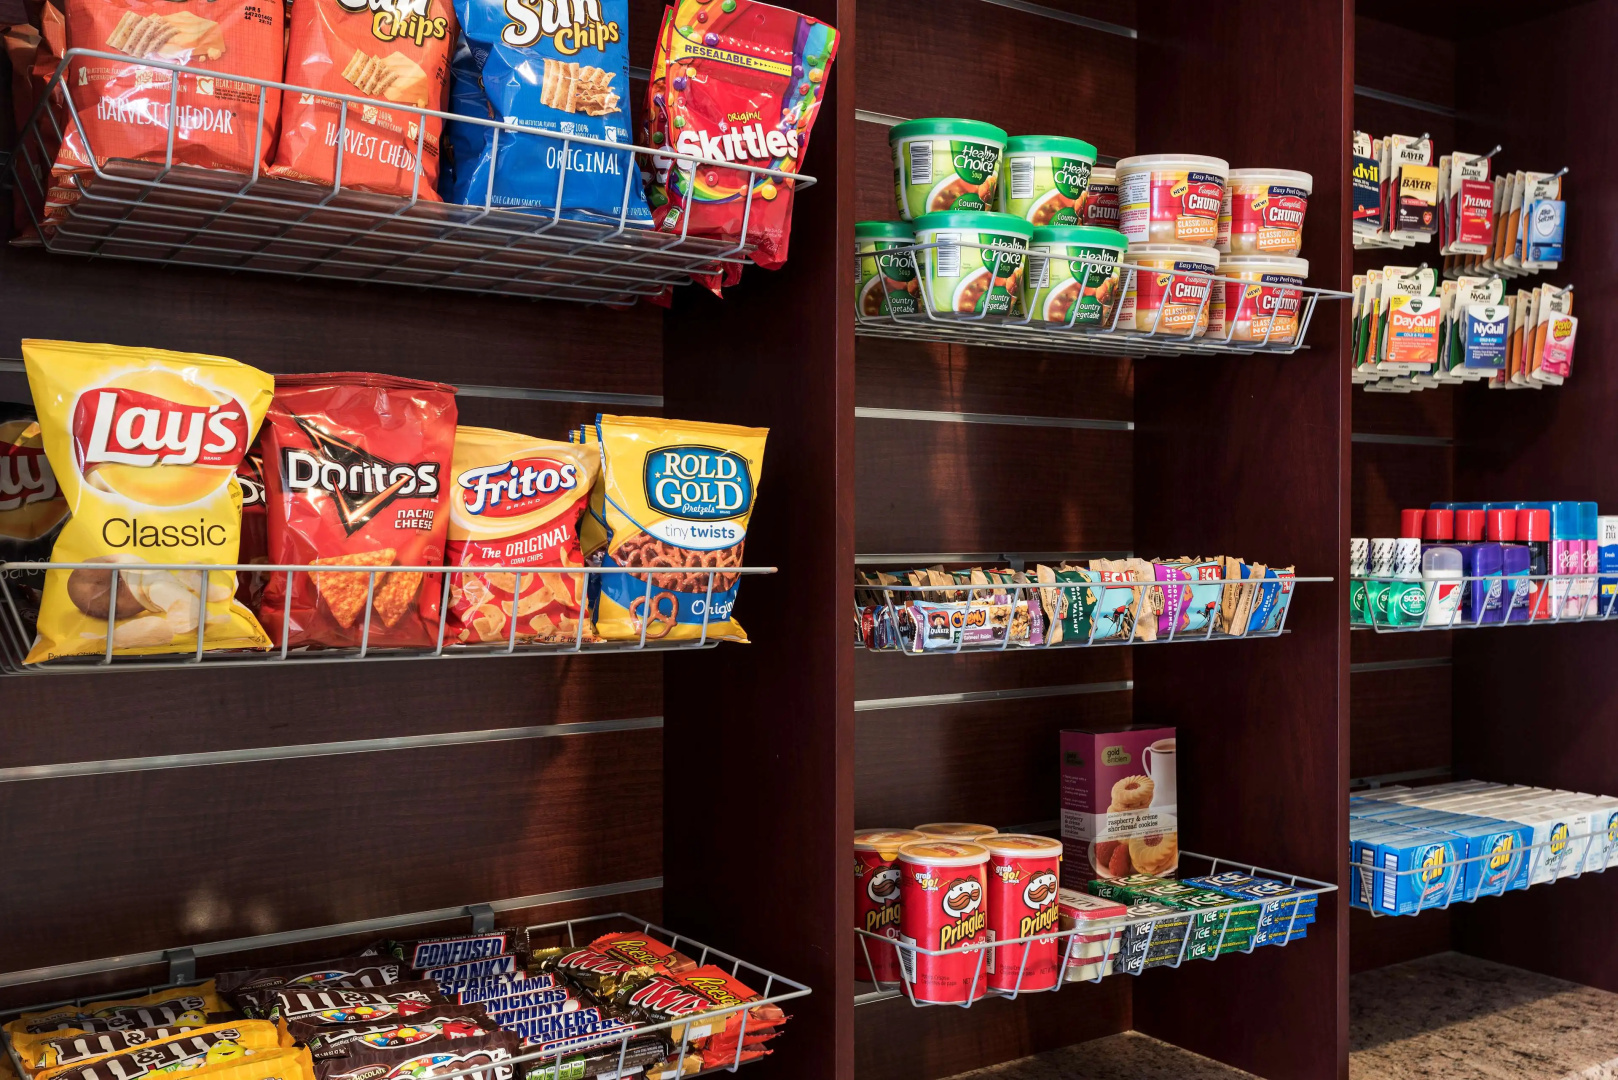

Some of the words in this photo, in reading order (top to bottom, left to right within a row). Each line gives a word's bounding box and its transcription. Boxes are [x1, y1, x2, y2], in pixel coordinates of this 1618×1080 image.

[372, 11, 448, 46] Chips
[553, 20, 620, 55] Chips
[684, 44, 753, 68] RESEALABLE
[164, 102, 233, 135] CHEDDAR
[575, 123, 589, 133] 100%
[325, 121, 378, 160] HARVEST
[378, 139, 426, 177] CHEDD
[676, 123, 799, 170] Skittles
[962, 144, 998, 163] Healthy
[546, 146, 621, 176] ORIGINAL
[1400, 150, 1424, 161] BAYER
[953, 155, 995, 173] Choice
[1063, 161, 1092, 176] Healthy
[971, 171, 983, 180] Soup
[1054, 170, 1089, 188] Choice
[1192, 173, 1205, 182] Easy
[1273, 186, 1286, 195] Easy
[1402, 179, 1432, 191] BAYER
[958, 198, 984, 211] Country
[1188, 193, 1221, 215] CHUNKY
[1463, 194, 1492, 209] TYLENOL
[1057, 212, 1078, 225] Country
[1088, 204, 1119, 220] CHUN
[1269, 206, 1304, 226] CHUNKY
[1178, 219, 1201, 228] CLASSIC
[1178, 226, 1214, 235] NOODLE
[1258, 230, 1282, 239] CLASSIC
[1259, 237, 1296, 245] NOODLE
[1078, 249, 1118, 264] Healthy
[1179, 262, 1192, 270] Easy
[1265, 275, 1280, 283] Easy
[1397, 283, 1422, 292] DayQuil
[888, 294, 915, 306] ountry
[1470, 292, 1492, 301] NyQuil
[1164, 307, 1188, 316] CLASSIC
[1393, 314, 1436, 330] DayQuil
[1473, 322, 1504, 336] NyQuil
[86, 391, 240, 467] Lay's
[286, 449, 438, 497] Doritos
[662, 452, 738, 480] ROLD
[457, 460, 577, 515] Fritos
[655, 477, 744, 510] GOLD
[505, 498, 541, 511] BRAND
[681, 503, 716, 515] Pretzels
[397, 508, 435, 520] NACHO
[394, 519, 433, 530] CHEESE
[102, 517, 227, 548] Classic
[665, 524, 690, 541] tiny
[690, 525, 736, 539] twists
[481, 547, 501, 559] The
[505, 524, 571, 557] ORIGINAL
[510, 556, 526, 566] CORN
[526, 552, 544, 563] CHIPS
[930, 627, 950, 635] QUAKER
[1106, 748, 1120, 758] gold
[1107, 824, 1137, 833] shortbread
[1138, 820, 1158, 829] cookies
[1108, 816, 1135, 826] raspberry
[1551, 823, 1568, 854] all
[1490, 833, 1514, 869] all
[995, 864, 1013, 873] grab
[1421, 845, 1445, 882] all
[1002, 870, 1020, 881] go!
[1206, 872, 1255, 887] ICE
[922, 878, 939, 890] go!
[1246, 881, 1296, 897] ICE
[1098, 888, 1112, 898] ICE
[1184, 892, 1234, 907] ICE
[1266, 900, 1280, 913] ICE
[866, 903, 901, 932] Pring
[1019, 901, 1059, 944] Pringles
[1203, 910, 1217, 923] ICE
[940, 909, 986, 951] Pringles
[1136, 921, 1152, 936] ICE
[1195, 926, 1211, 940] ICE
[415, 937, 503, 968] CONFUSED
[1132, 939, 1147, 953] ICE
[1192, 942, 1206, 957] ICE
[429, 956, 512, 983] CRANKY
[1127, 955, 1143, 971] ICE
[461, 981, 509, 1005] DRAMA
[510, 976, 552, 995] MAMA
[495, 1001, 566, 1025] WHINY
